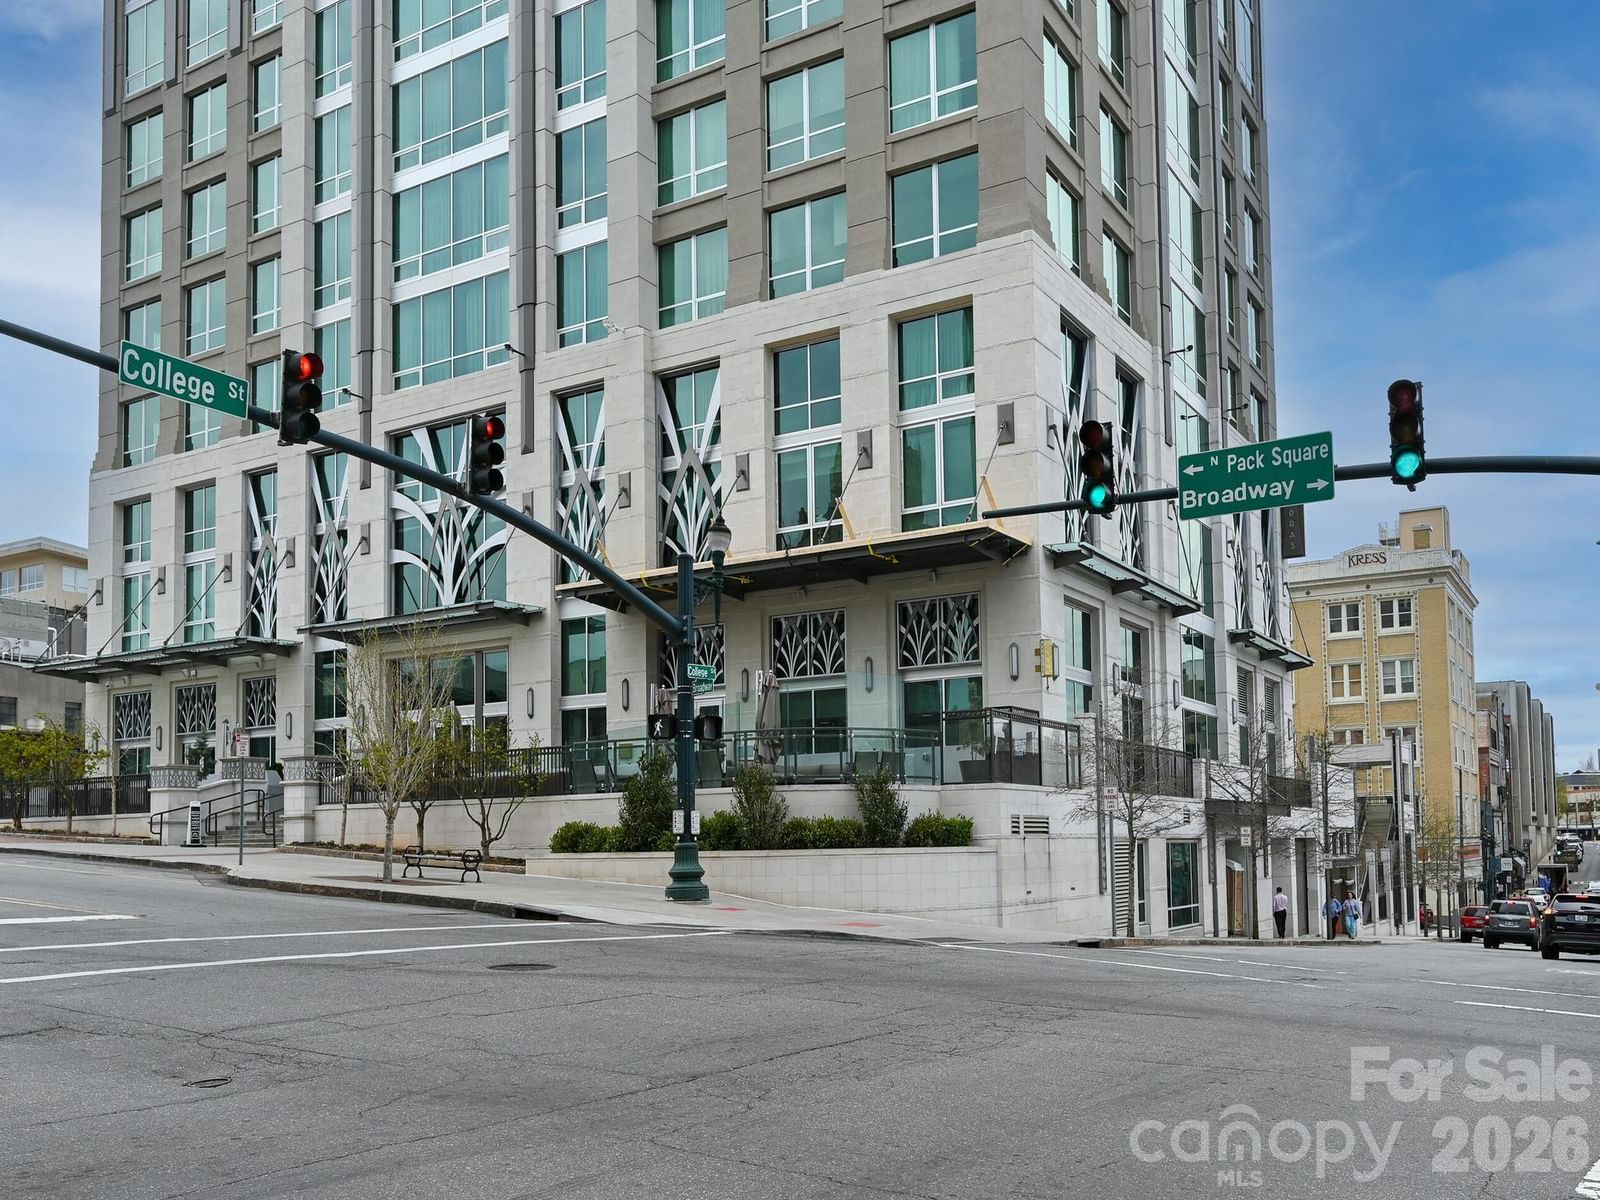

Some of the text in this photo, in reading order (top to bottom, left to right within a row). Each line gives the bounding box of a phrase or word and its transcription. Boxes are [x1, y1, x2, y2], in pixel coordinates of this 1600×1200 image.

[122, 348, 245, 404] College St
[1210, 443, 1329, 473] N Pack Square
[1182, 479, 1295, 509] Broadway
[1348, 551, 1387, 568] KRESS
[688, 665, 708, 678] College
